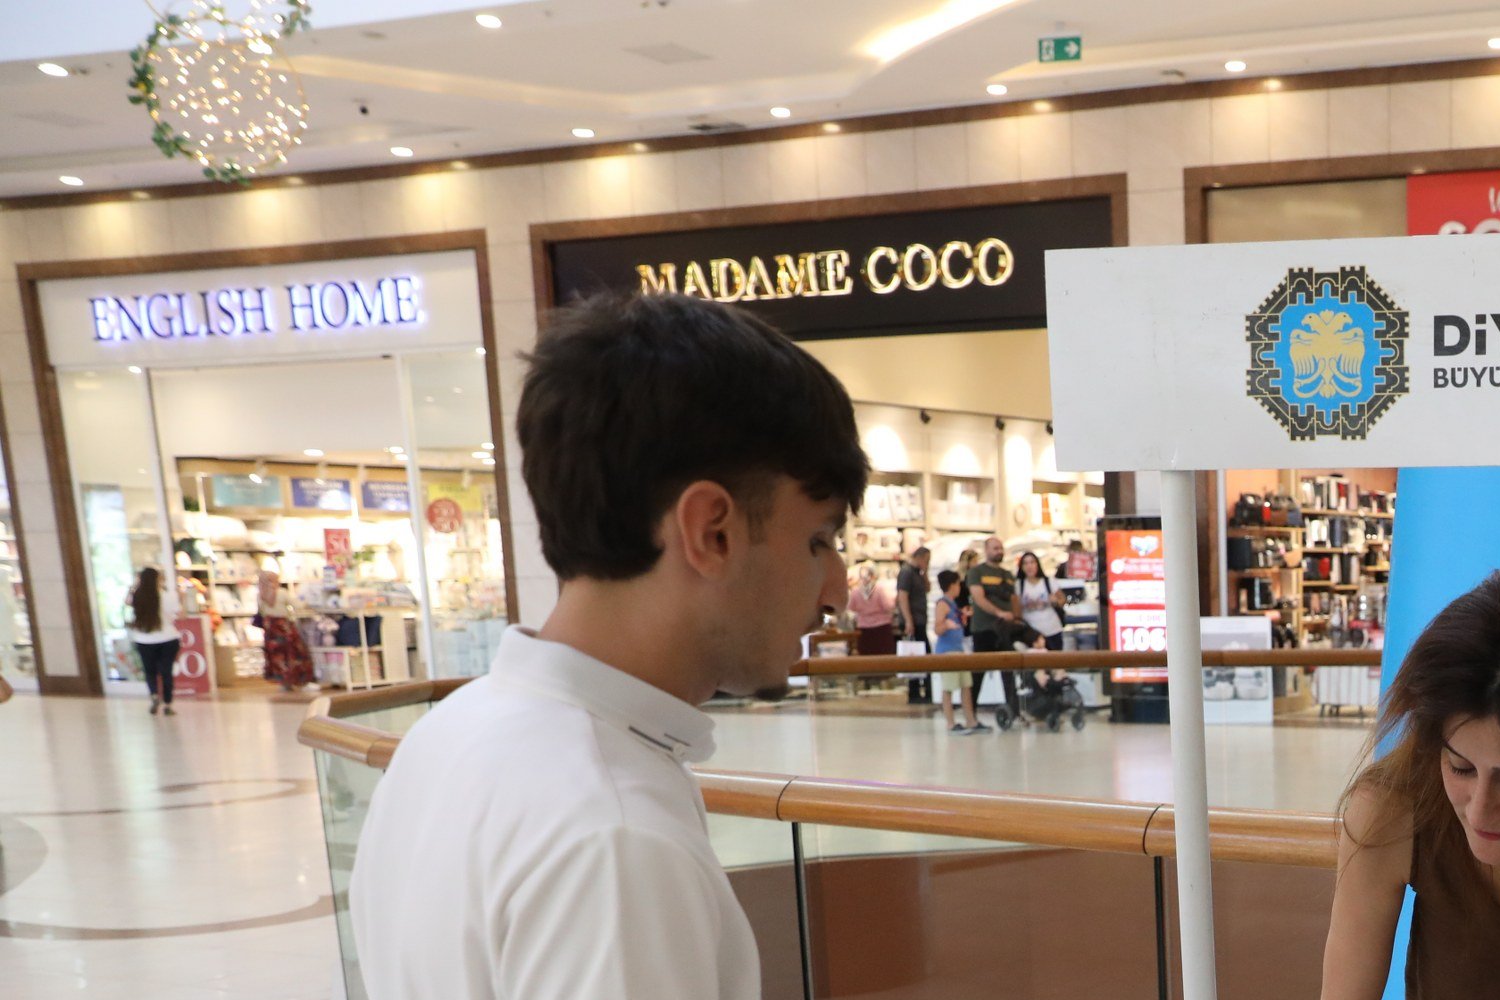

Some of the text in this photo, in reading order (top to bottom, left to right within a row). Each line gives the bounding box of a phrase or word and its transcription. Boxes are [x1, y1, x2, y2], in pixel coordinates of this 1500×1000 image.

[636, 237, 1015, 303] MADAME COCO
[88, 275, 428, 342] ENGLISH HOME
